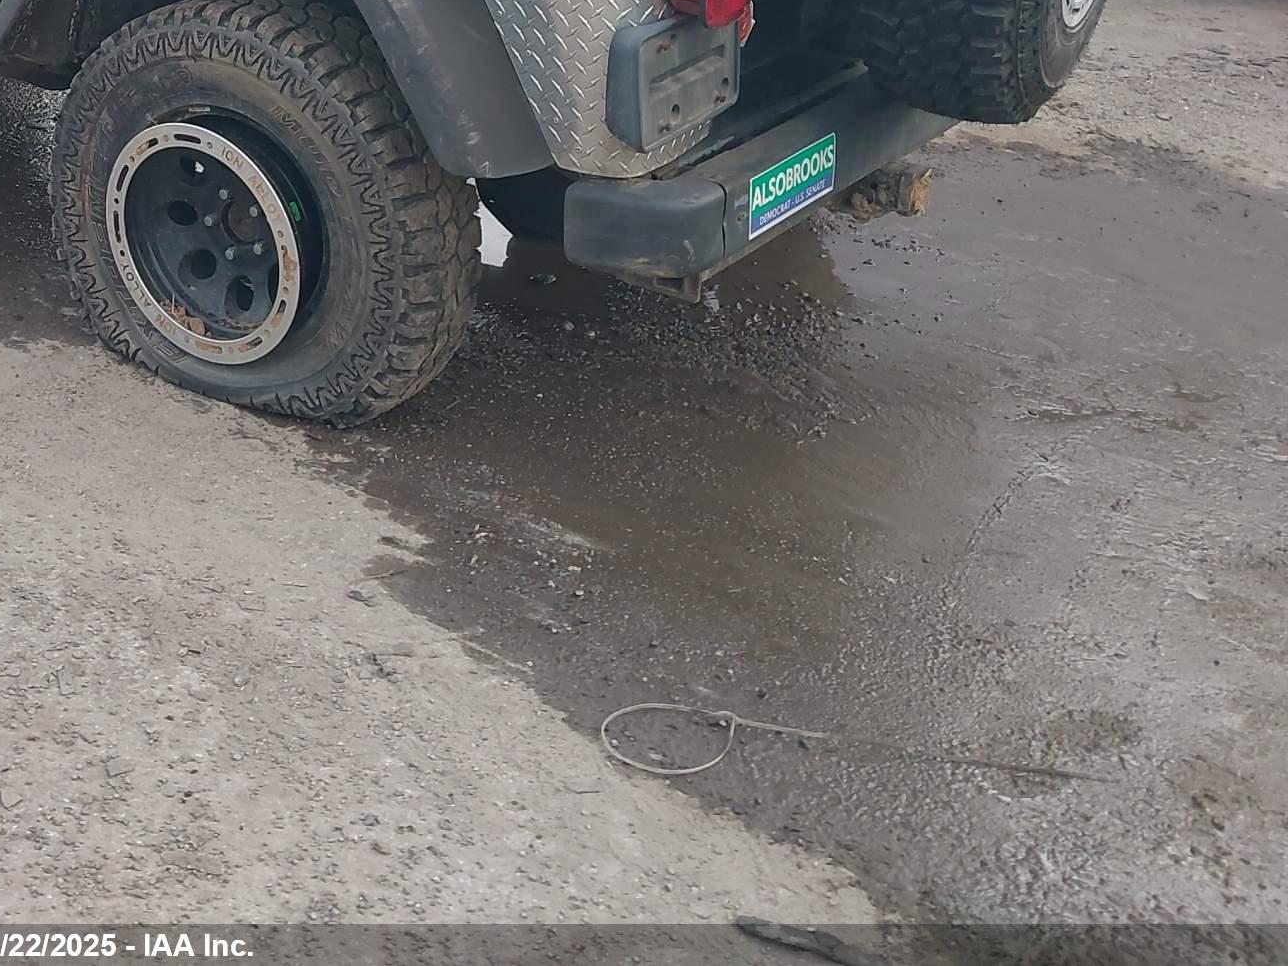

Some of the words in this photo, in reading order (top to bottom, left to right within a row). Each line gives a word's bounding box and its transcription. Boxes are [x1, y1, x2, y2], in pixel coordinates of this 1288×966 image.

[221, 147, 244, 169] ION
[752, 144, 833, 211] ALSOBROOKS
[759, 199, 791, 225] DEMOCRAT
[805, 179, 826, 198] SENATE
[120, 263, 152, 308] ALLOY
[155, 313, 177, 337] ION
